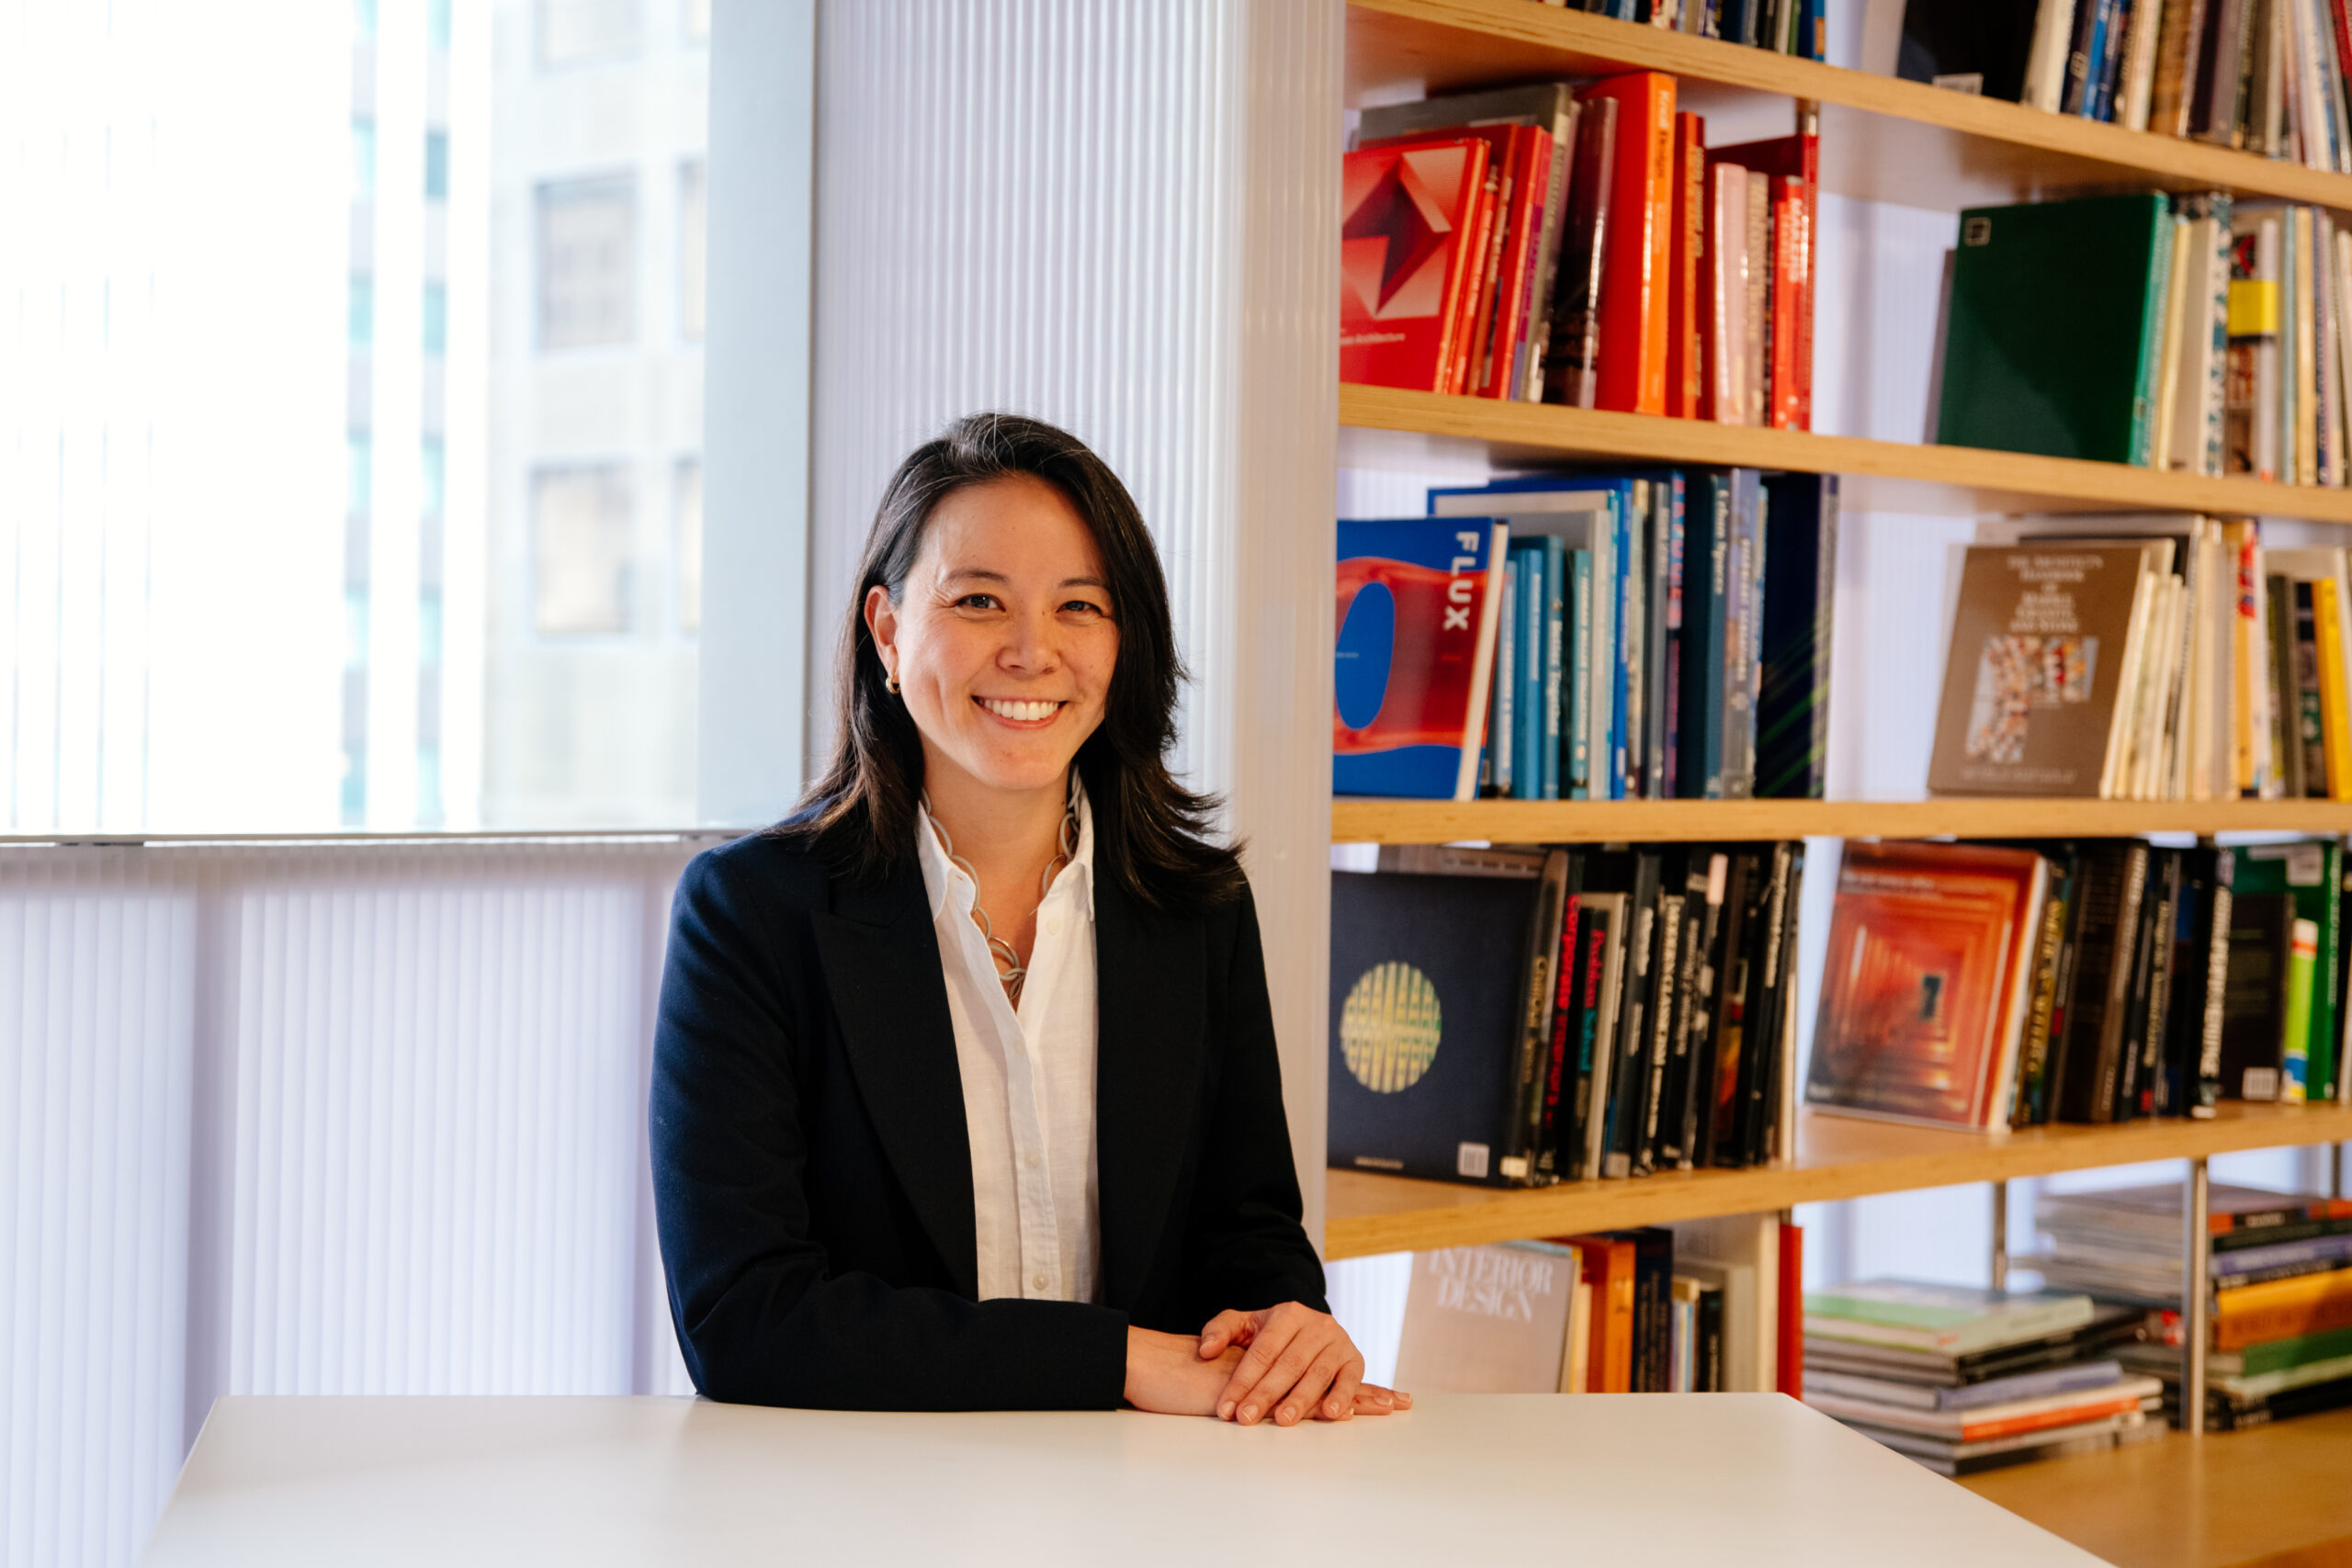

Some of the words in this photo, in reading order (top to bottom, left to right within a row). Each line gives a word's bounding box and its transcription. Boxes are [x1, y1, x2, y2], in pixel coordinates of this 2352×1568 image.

[1714, 490, 1729, 539] Urban
[1443, 532, 1479, 630] FLUX
[1546, 671, 1562, 735] Together
[1556, 895, 1581, 1010] Corporate
[1584, 930, 1606, 1008] Problem
[1547, 1014, 1567, 1106] Interiors
[1579, 1009, 1597, 1071] Solved
[1429, 1247, 1554, 1296] INTERIOR
[1437, 1275, 1538, 1323] DESIGN
